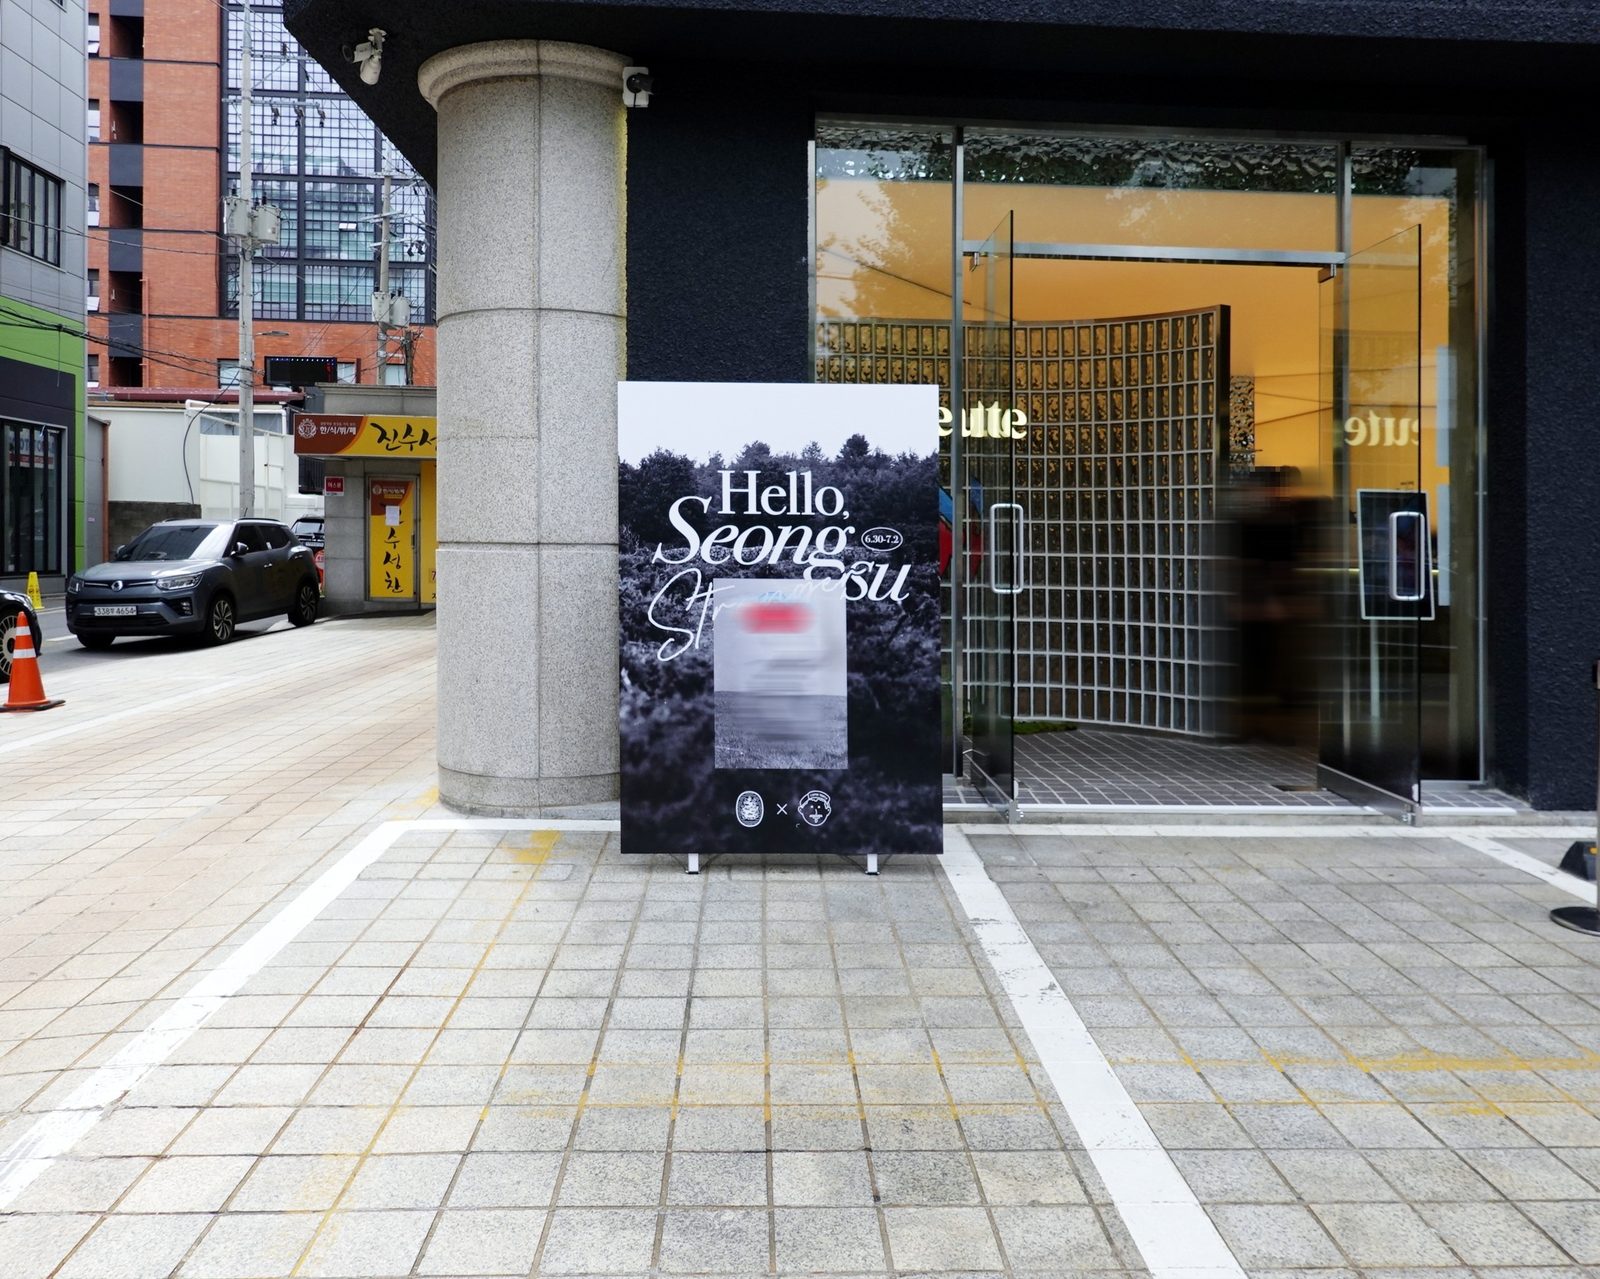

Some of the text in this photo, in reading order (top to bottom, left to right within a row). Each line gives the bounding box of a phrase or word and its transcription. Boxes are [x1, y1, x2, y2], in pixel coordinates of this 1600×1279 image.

[717, 470, 849, 519] Hello,
[380, 503, 405, 593] 수성찬
[652, 496, 855, 581] Seong
[864, 534, 900, 544] 6.30-7.2
[845, 561, 911, 601] su
